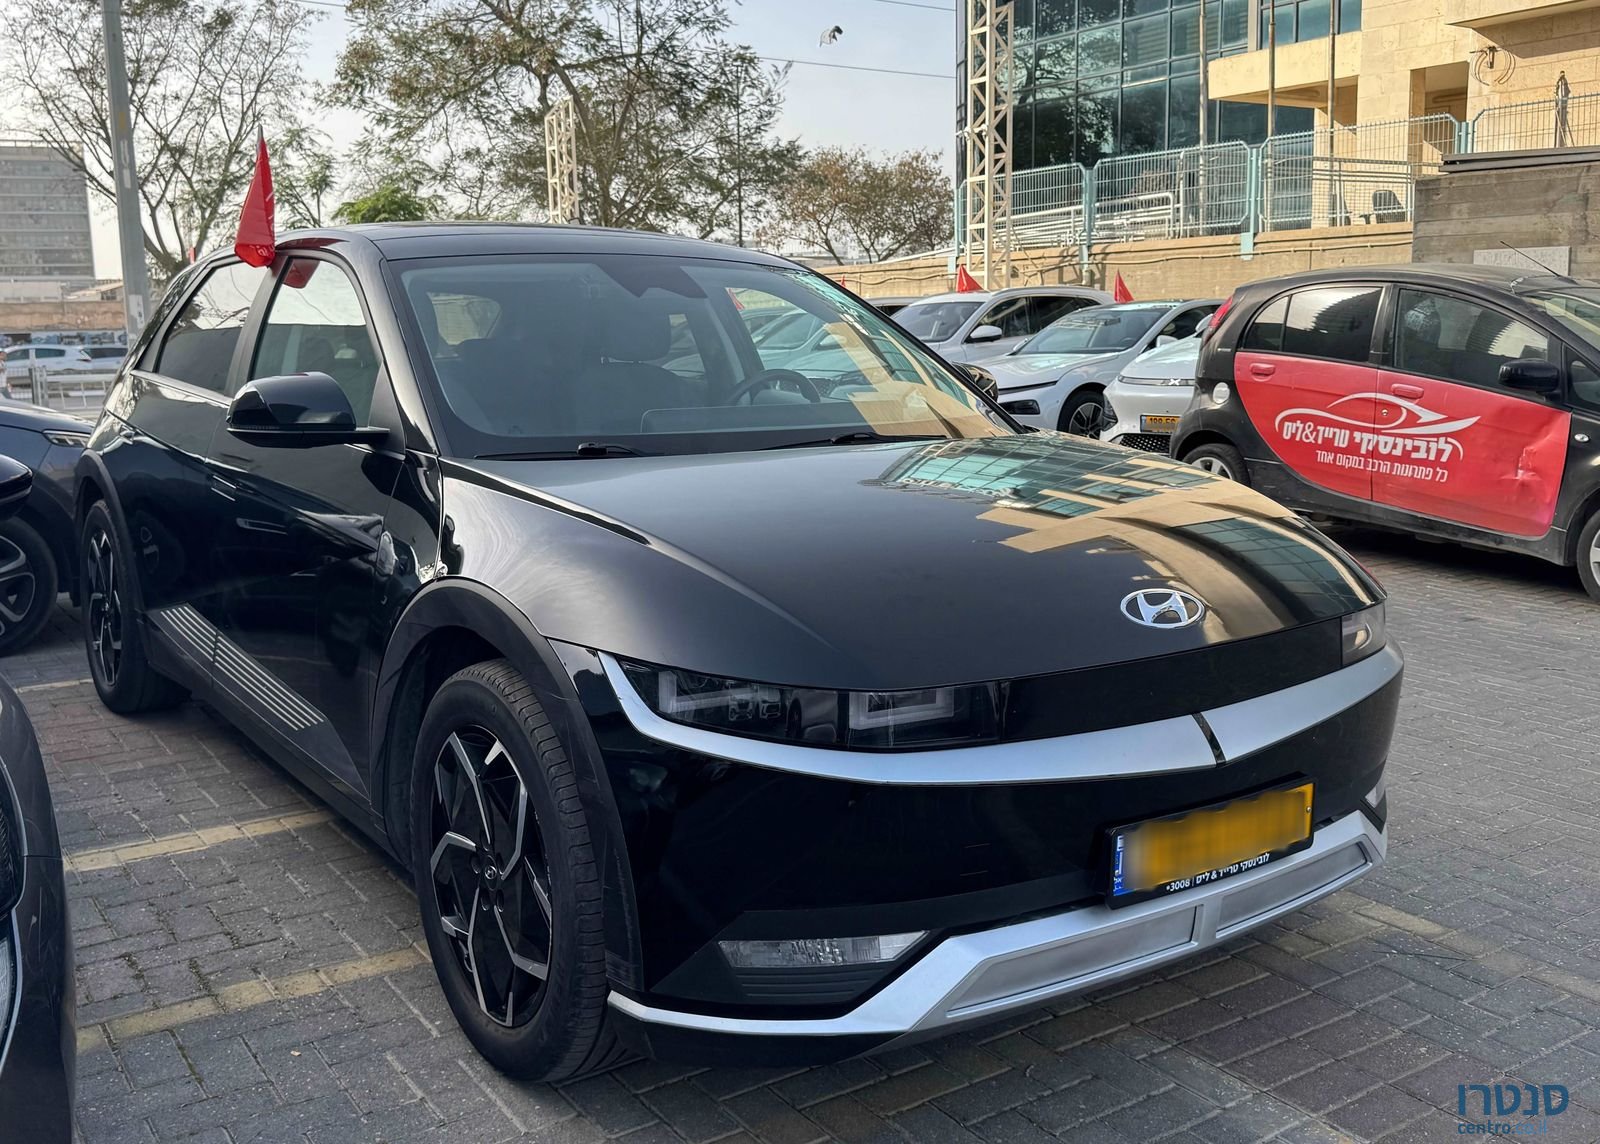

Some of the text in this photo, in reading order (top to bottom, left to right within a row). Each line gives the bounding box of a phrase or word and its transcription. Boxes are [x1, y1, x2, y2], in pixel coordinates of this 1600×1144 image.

[1353, 431, 1453, 462] לובינסקי
[1316, 450, 1449, 482] כל פתרונות הרכב במקום אחד
[1219, 864, 1239, 877] טרייד
[1240, 852, 1271, 872] לובינסקי
[1210, 870, 1218, 879] &
